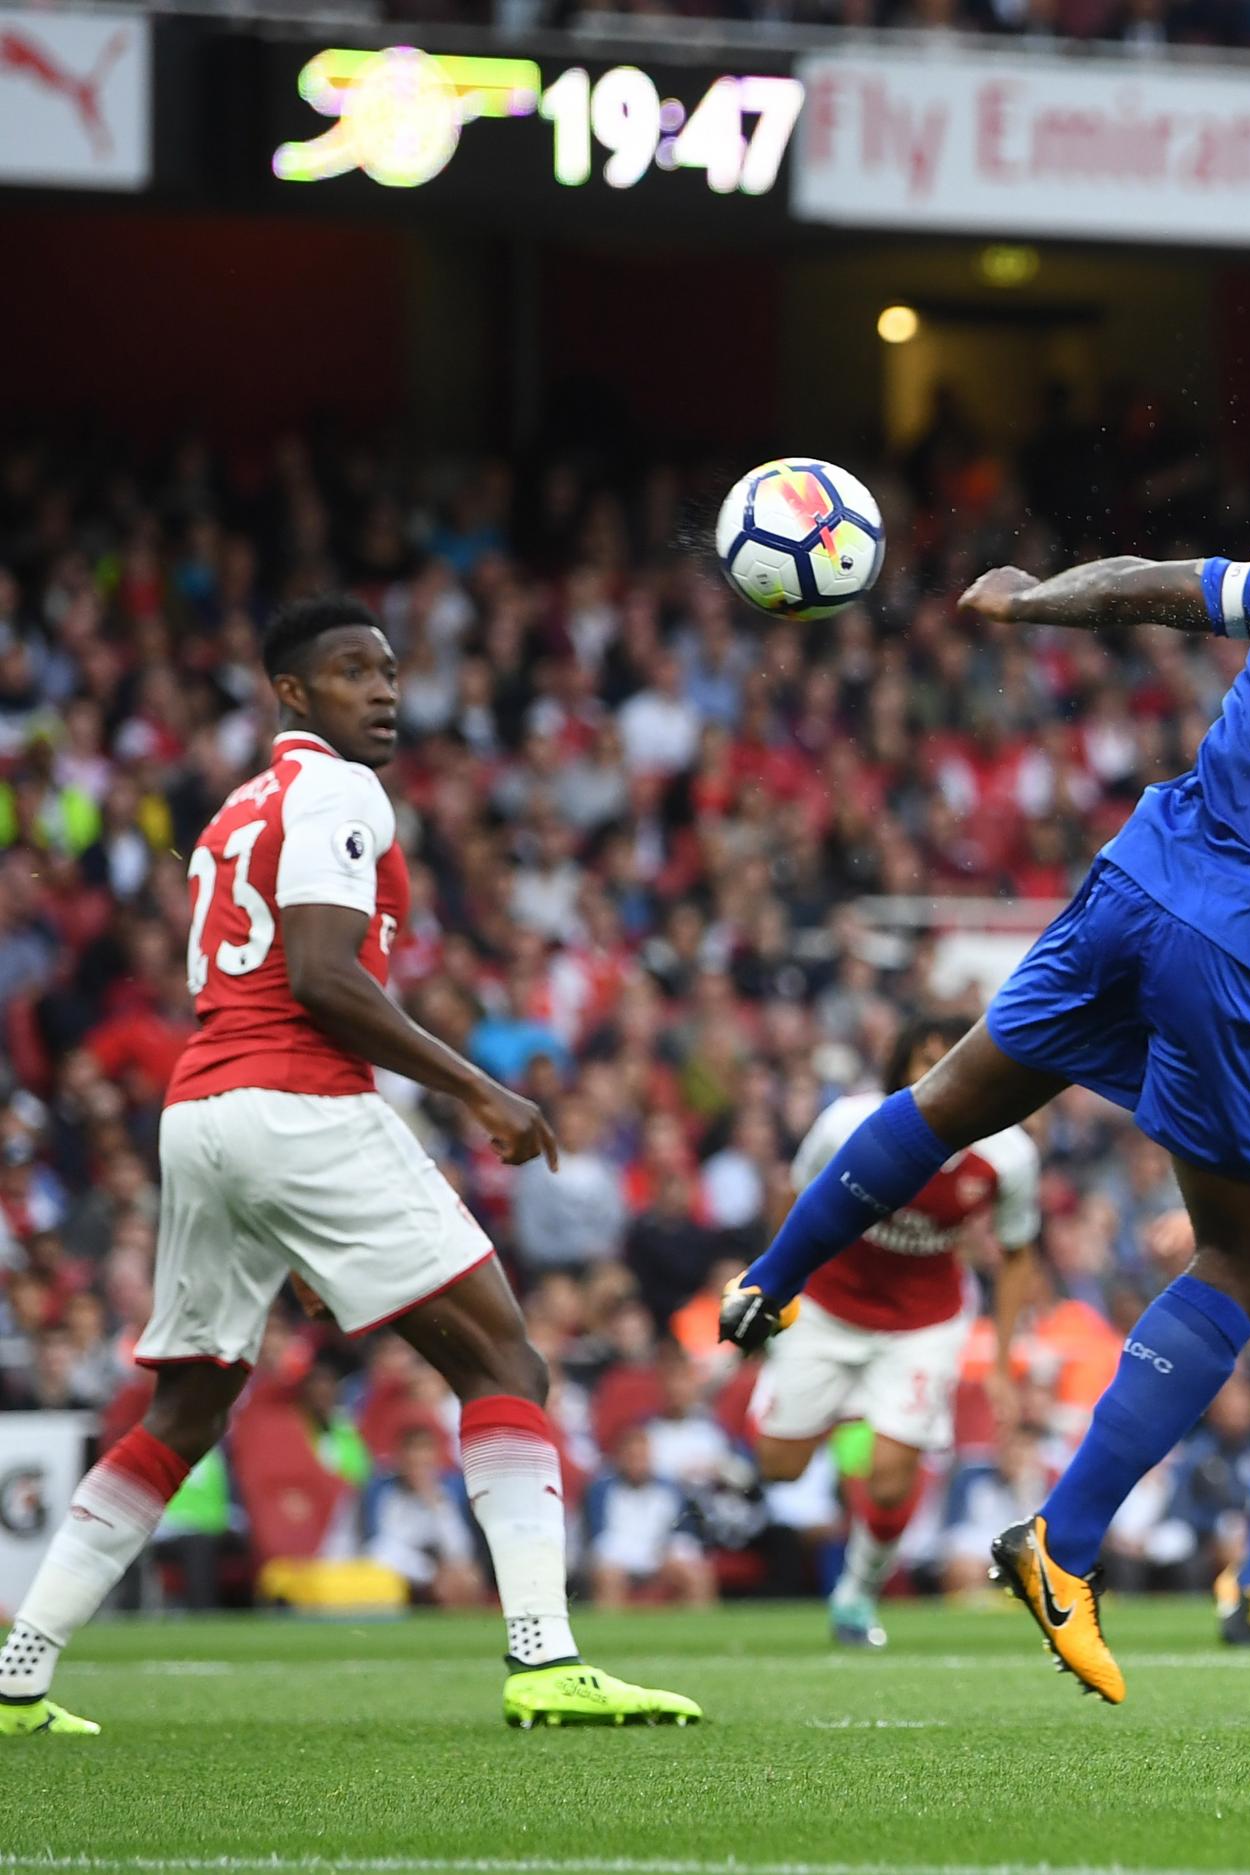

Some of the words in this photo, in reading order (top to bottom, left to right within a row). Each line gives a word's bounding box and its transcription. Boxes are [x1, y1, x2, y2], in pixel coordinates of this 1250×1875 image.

[538, 66, 806, 195] 19:47
[805, 70, 948, 204] Fly
[187, 819, 276, 996] 23
[1124, 1338, 1174, 1374] LCFC
